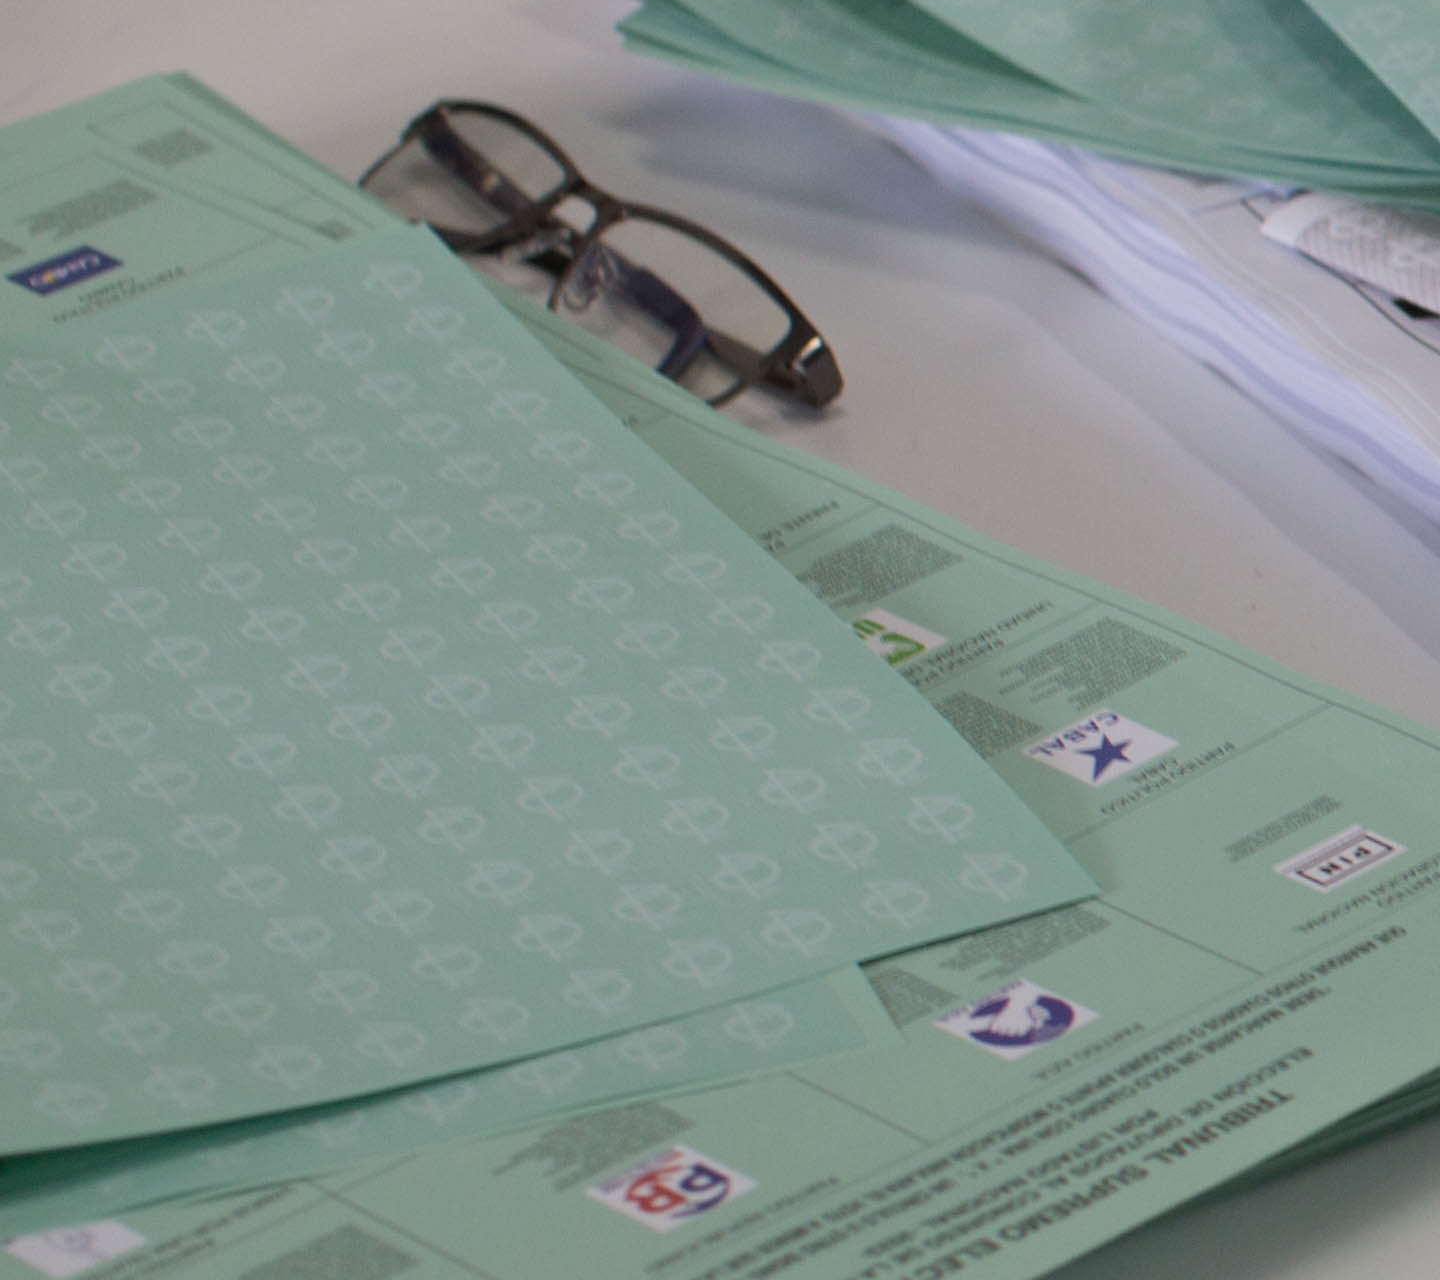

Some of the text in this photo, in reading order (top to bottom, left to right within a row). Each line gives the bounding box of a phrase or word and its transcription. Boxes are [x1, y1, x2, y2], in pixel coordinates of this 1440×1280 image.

[1023, 709, 1124, 761] CABAL
[1314, 845, 1376, 877] PIN
[1138, 1085, 1298, 1169] TRIBUNAL
[1178, 1097, 1220, 1119] DE
[1065, 1113, 1189, 1178] DIPUTADOS
[991, 1161, 1153, 1245] SUPREMO
